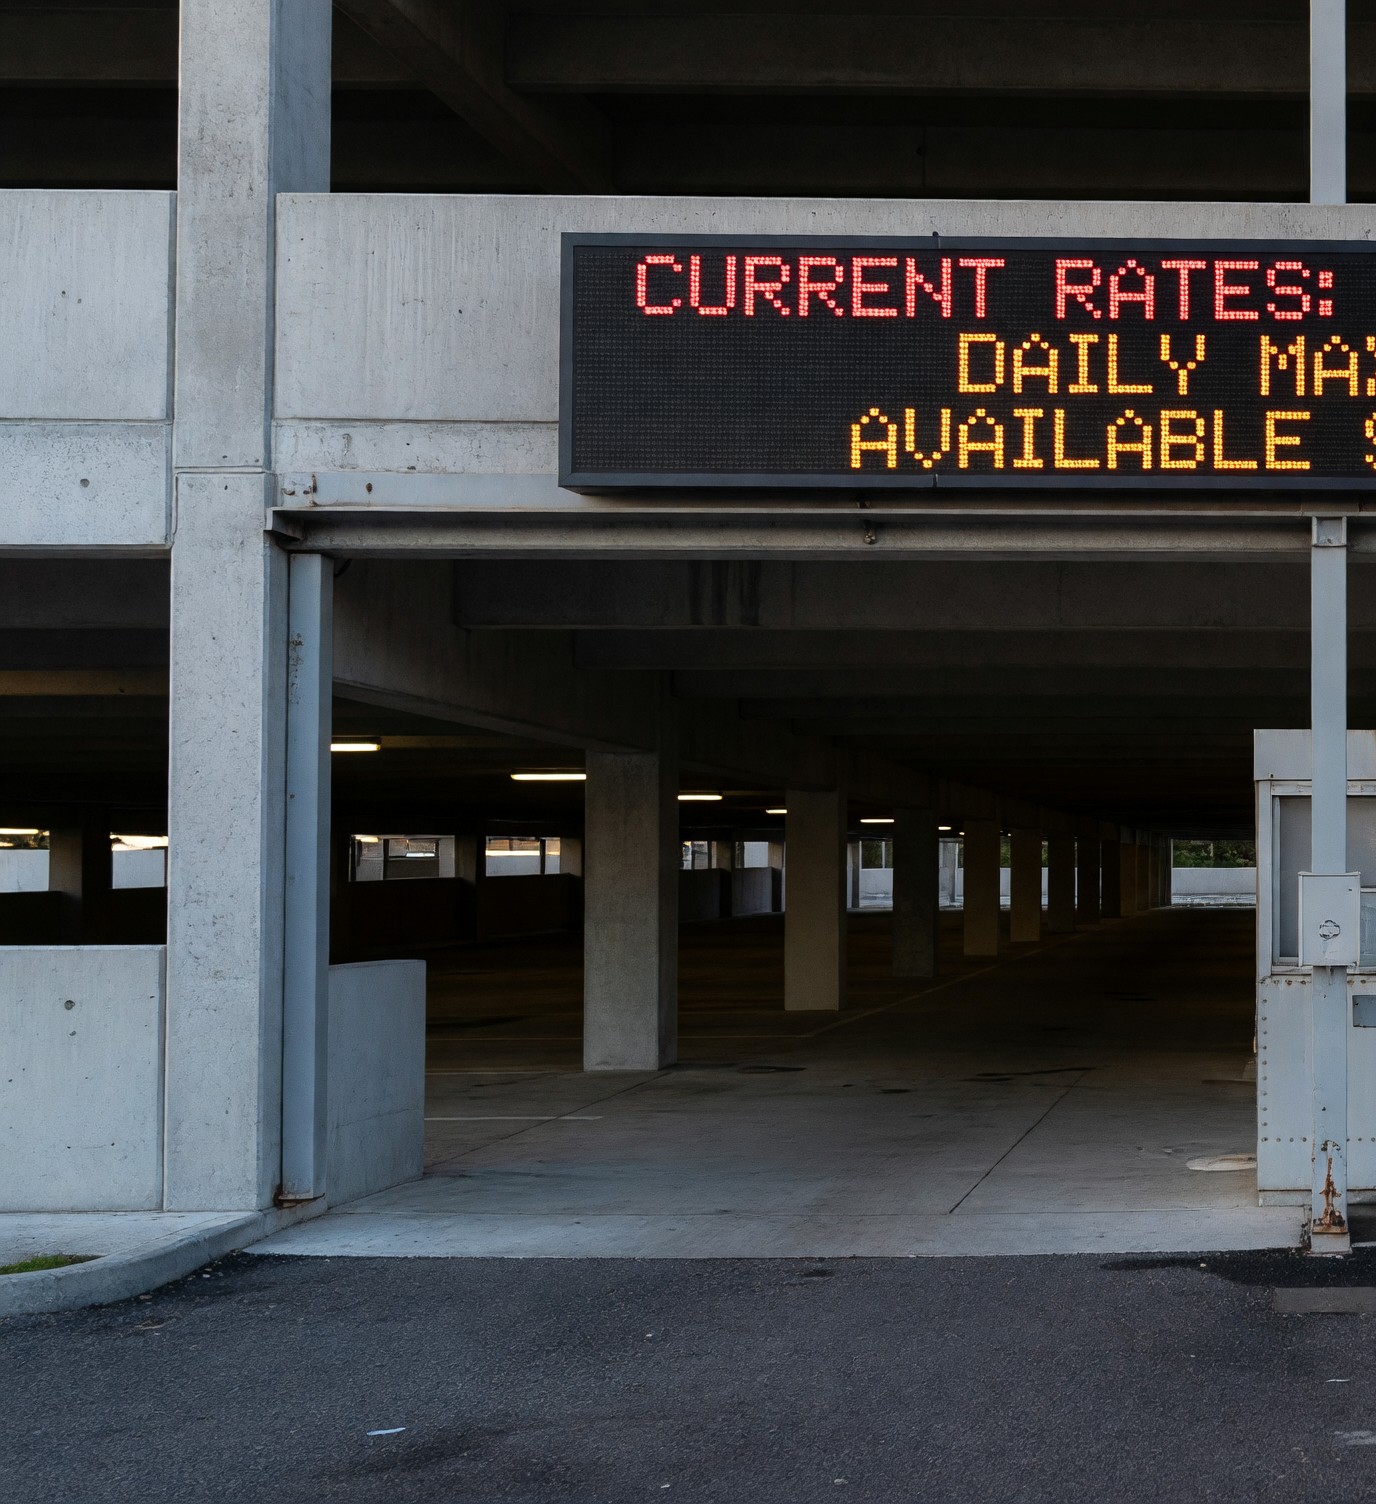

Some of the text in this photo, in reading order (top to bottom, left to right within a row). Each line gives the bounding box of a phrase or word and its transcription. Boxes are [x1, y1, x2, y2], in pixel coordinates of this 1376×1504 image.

[636, 254, 1005, 318] CURRENT
[1056, 258, 1333, 320] RATES:
[958, 333, 1205, 395] DAILY
[850, 408, 1310, 470] AVAILABLE
